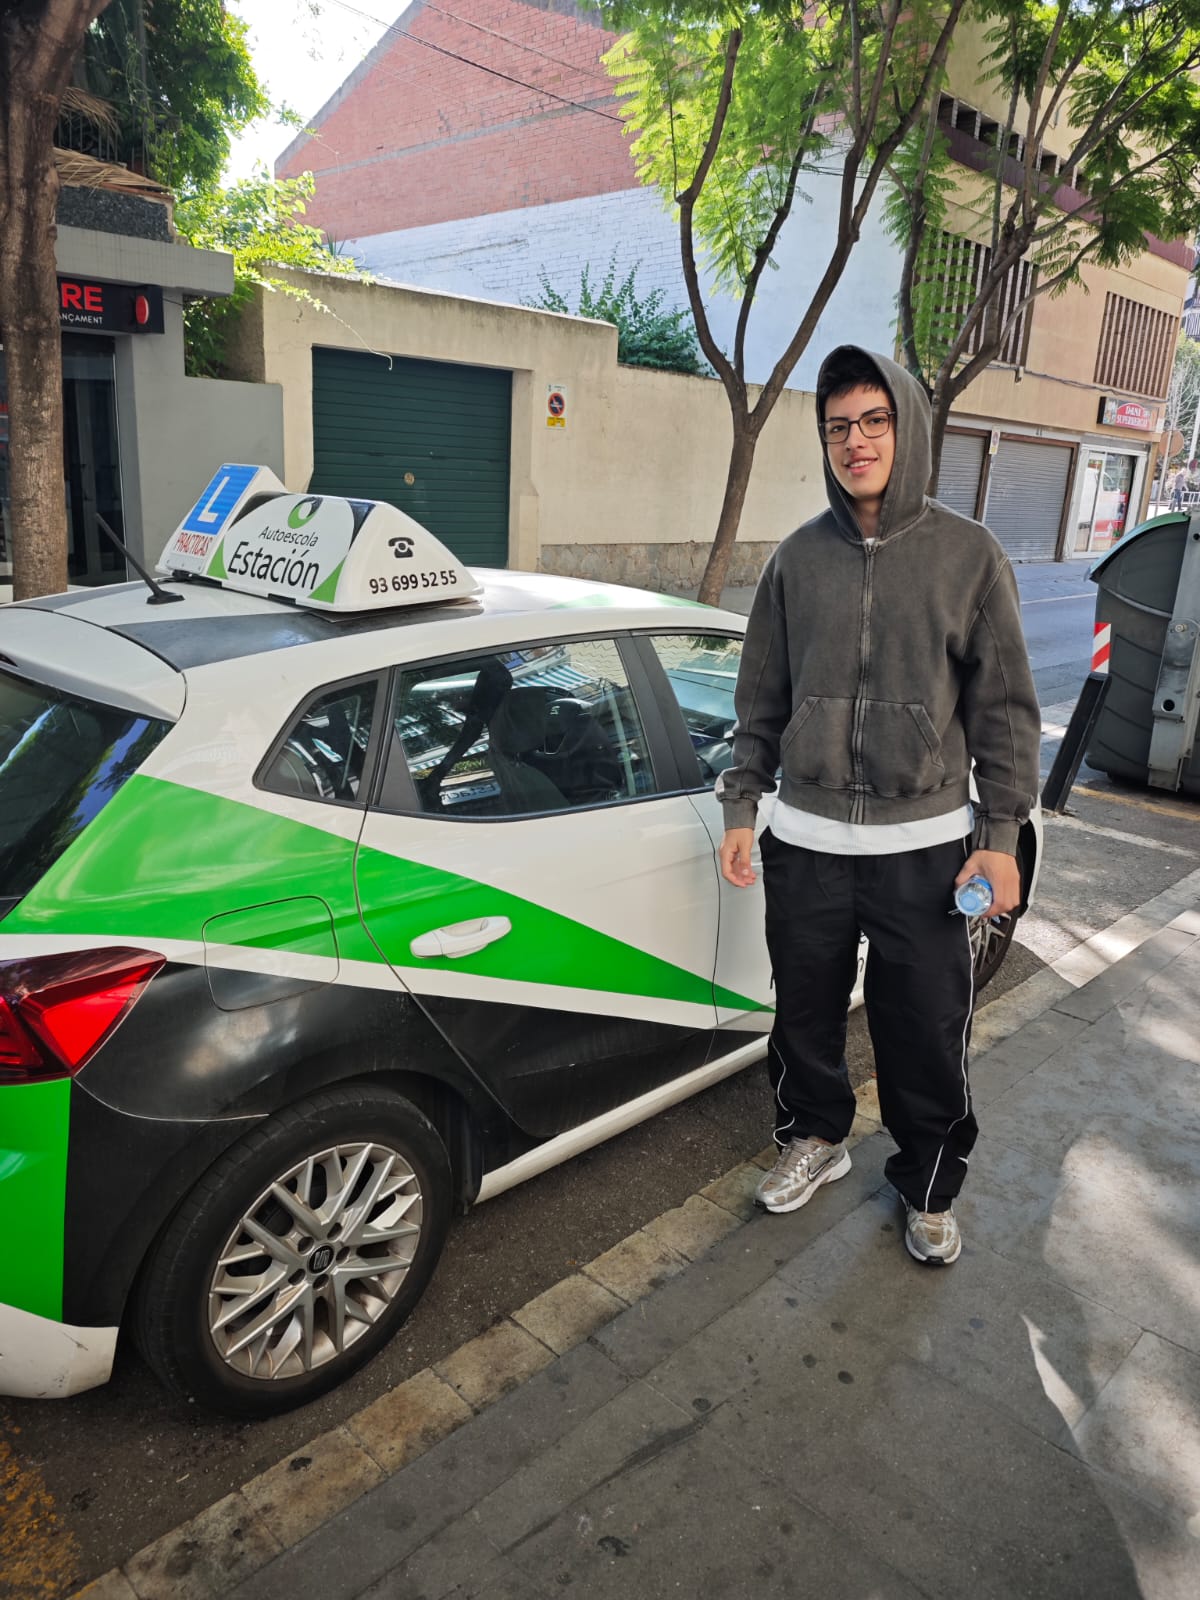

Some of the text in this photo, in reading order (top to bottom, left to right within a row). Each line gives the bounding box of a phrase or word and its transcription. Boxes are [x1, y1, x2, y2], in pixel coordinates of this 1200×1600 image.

[197, 476, 230, 523] L
[258, 526, 319, 548] Autoescola
[227, 541, 320, 590] Estación
[369, 569, 457, 594] 93 699 52 55
